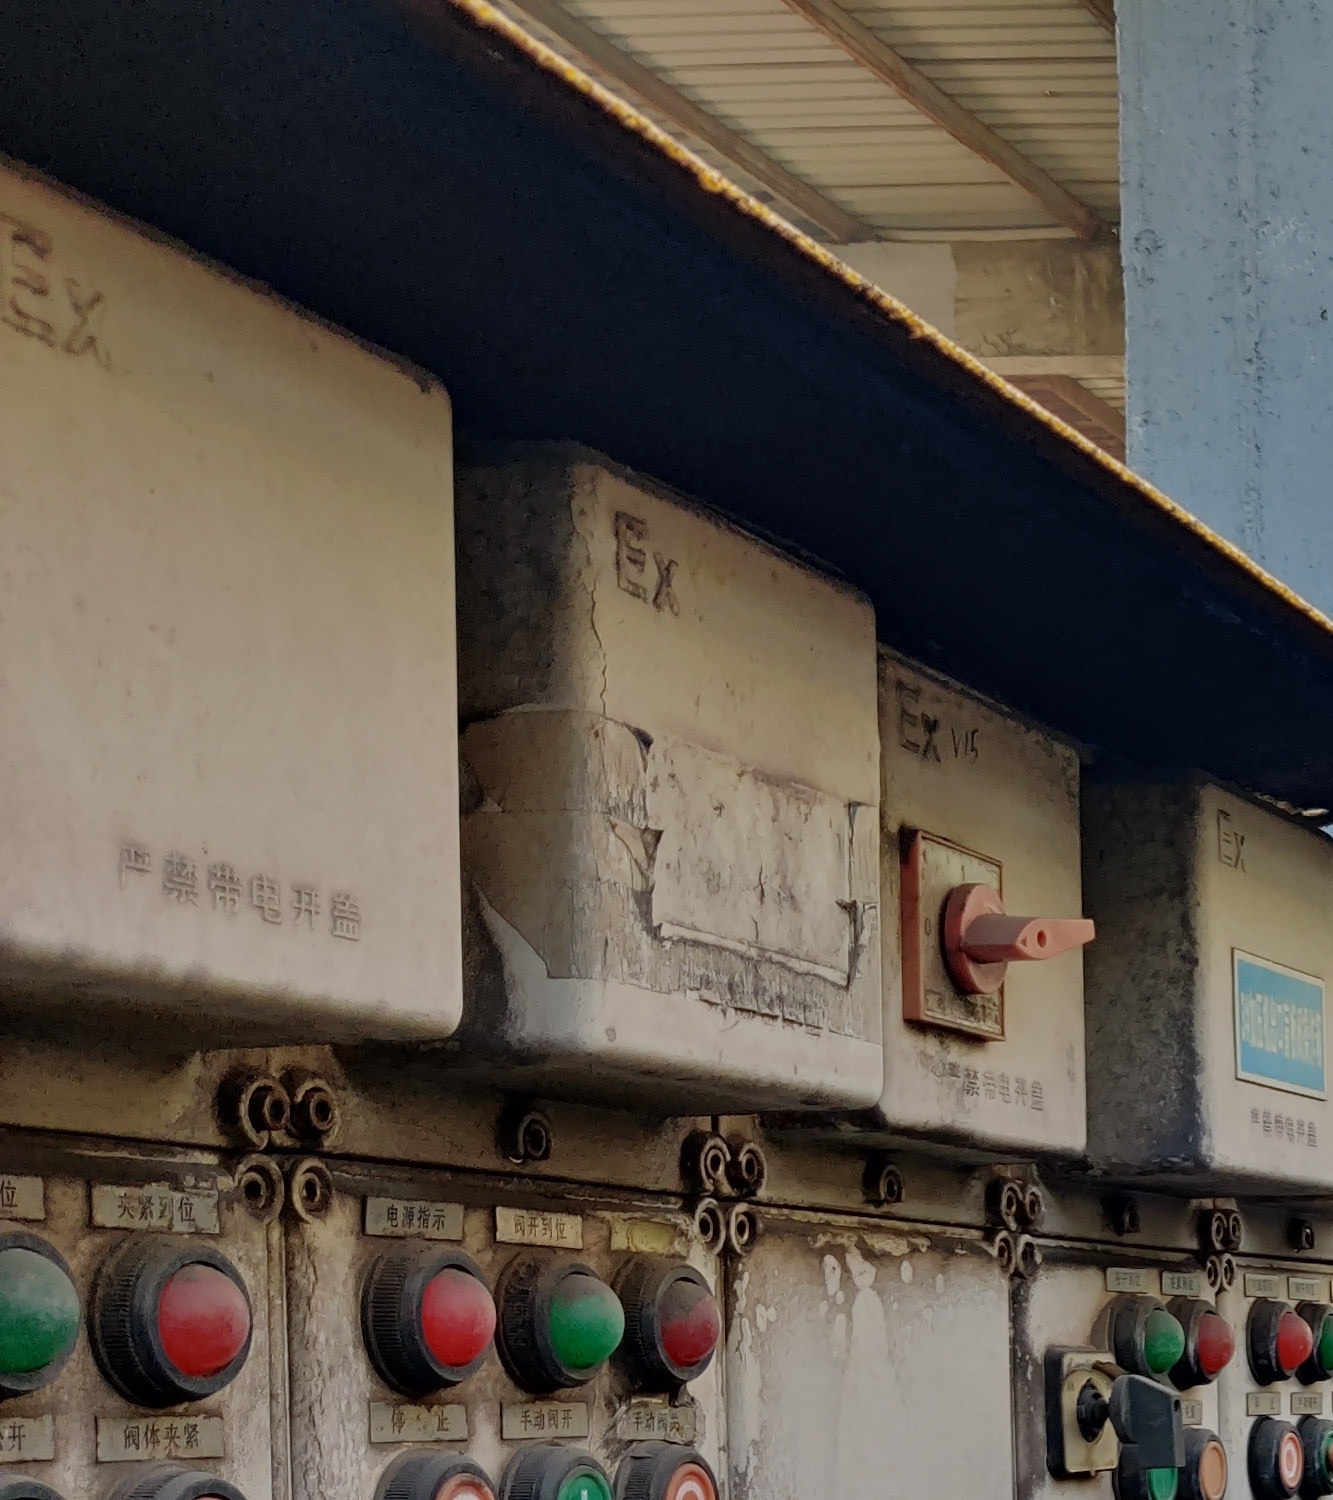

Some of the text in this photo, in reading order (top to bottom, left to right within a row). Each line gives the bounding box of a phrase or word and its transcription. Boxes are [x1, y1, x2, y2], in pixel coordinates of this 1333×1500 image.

[117, 844, 362, 942] 严禁带电开盖
[116, 1191, 196, 1224] 夹紧到位
[386, 1204, 447, 1231] 电源指示
[513, 1213, 568, 1241] 阀开到位
[519, 1408, 573, 1431] 手动阀开
[123, 1423, 201, 1451] 阀体夹紧
